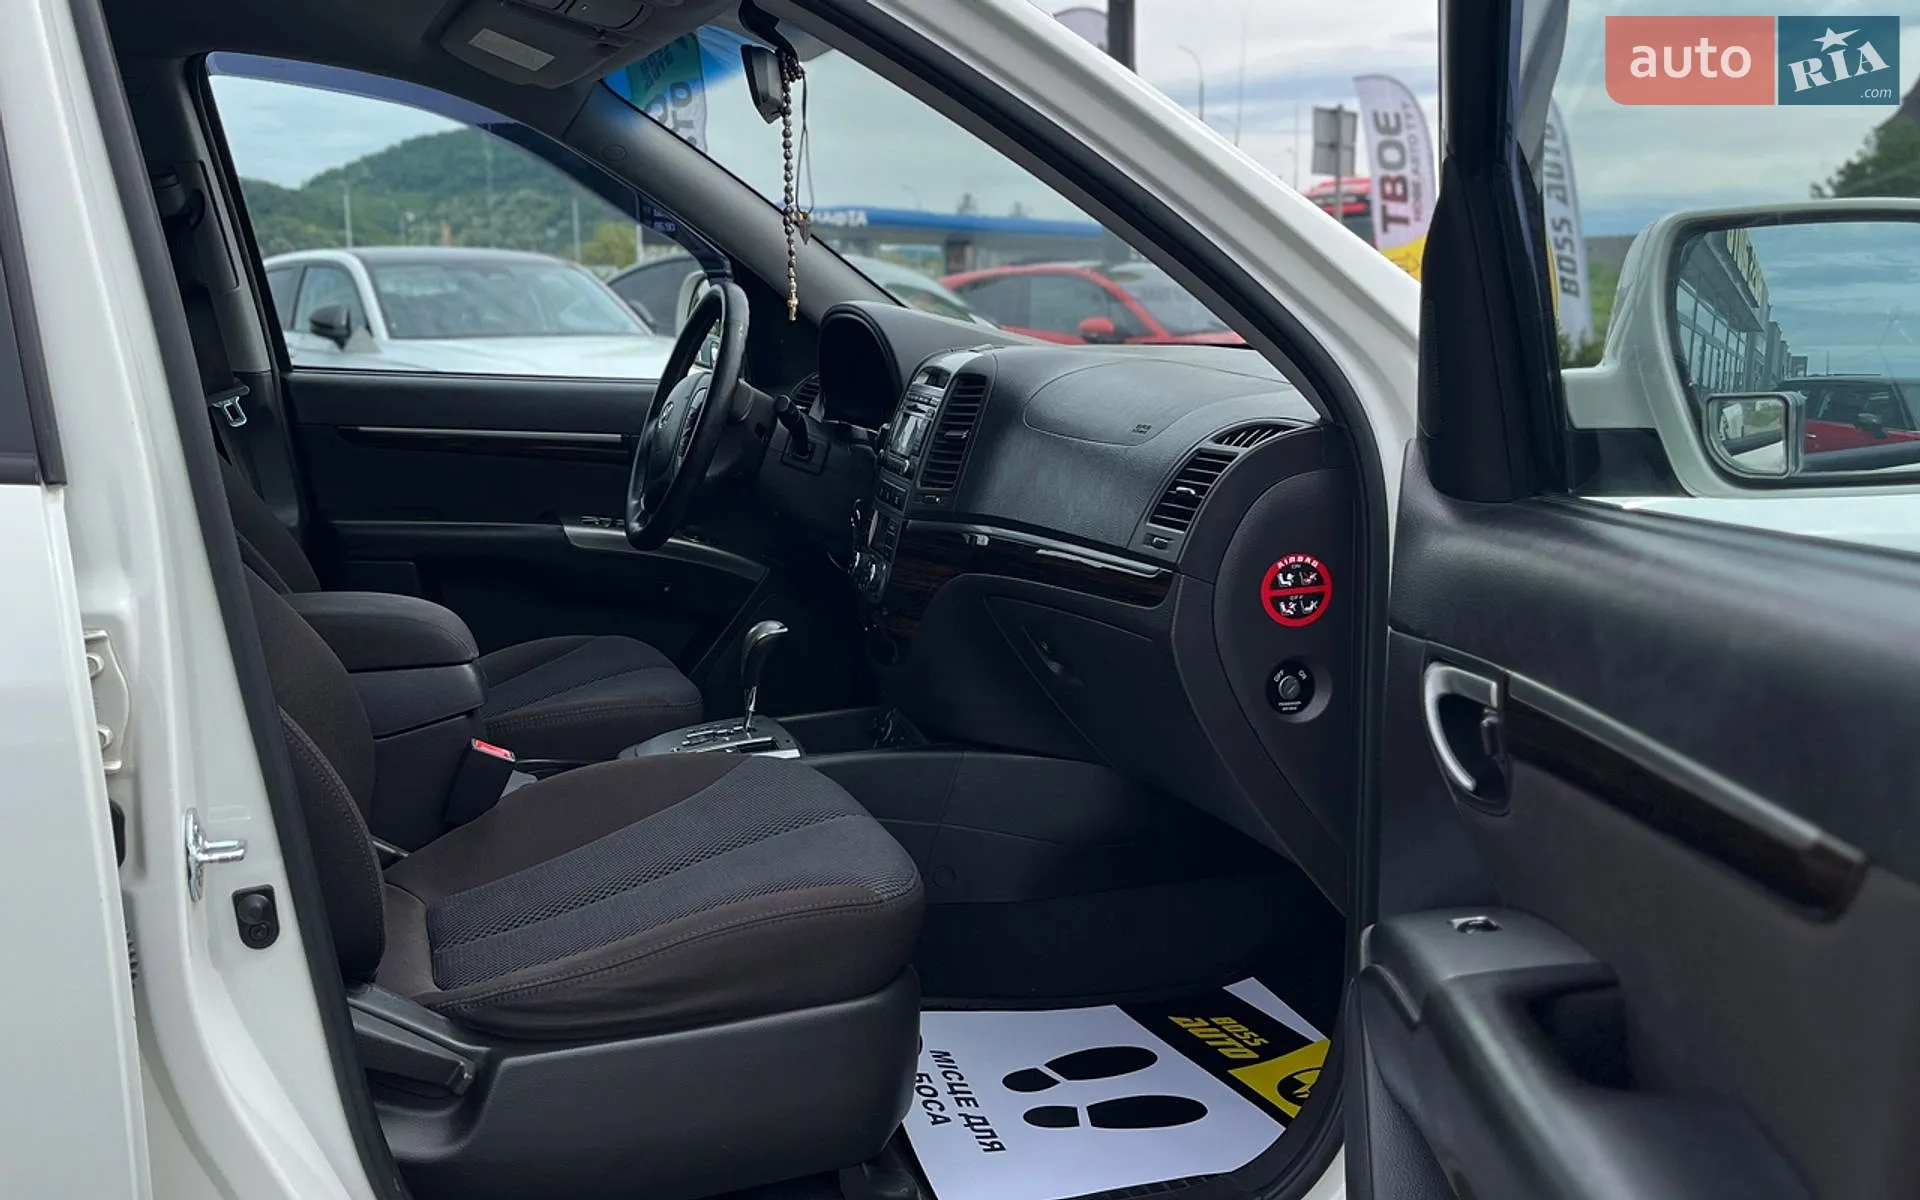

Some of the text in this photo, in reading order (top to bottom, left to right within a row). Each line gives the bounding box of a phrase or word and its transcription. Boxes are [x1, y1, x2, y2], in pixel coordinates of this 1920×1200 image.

[1551, 216, 1581, 298] BOSS
[1277, 556, 1319, 569] AIRBAG
[1168, 1015, 1260, 1059] AUTO
[1210, 1016, 1270, 1047] BOSS
[929, 1049, 1006, 1152] МІСЦЕ ДЛЯ
